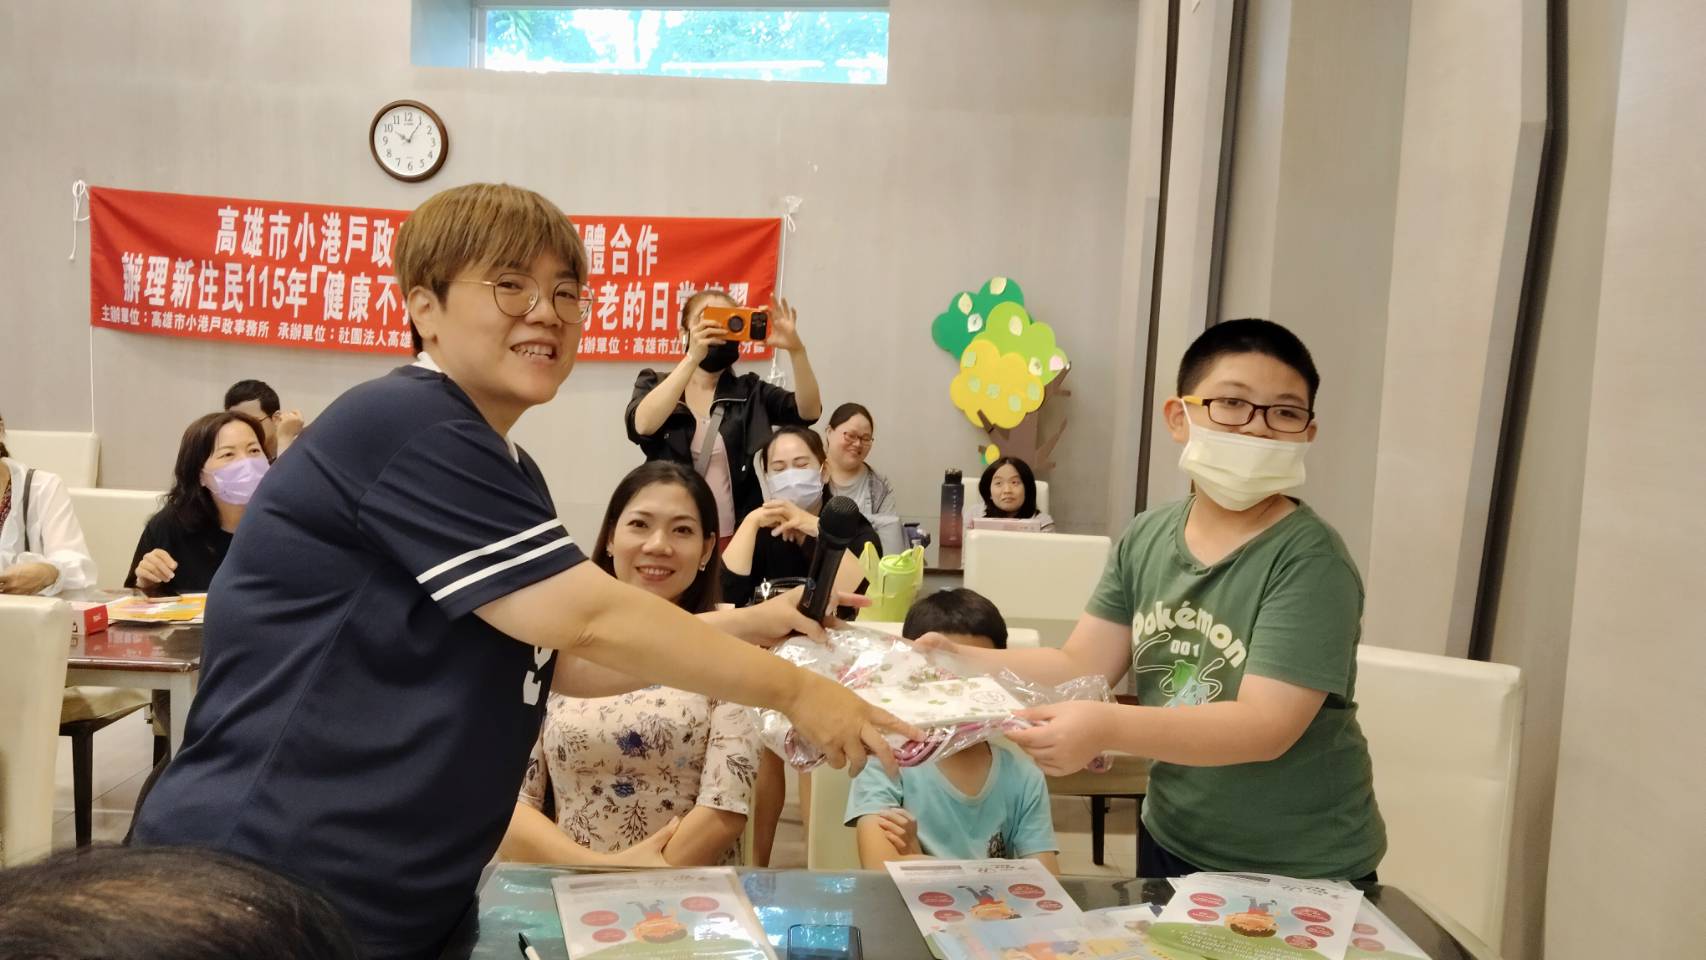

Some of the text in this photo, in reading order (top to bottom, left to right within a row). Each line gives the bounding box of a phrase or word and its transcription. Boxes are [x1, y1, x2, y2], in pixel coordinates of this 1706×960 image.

[393, 115, 401, 125] 11
[404, 111, 413, 122] 12
[384, 123, 394, 133] 10
[427, 125, 433, 136] 2
[382, 135, 389, 146] 9
[431, 137, 436, 148] 3
[386, 148, 393, 158] 8
[427, 150, 433, 159] 4
[395, 157, 401, 167] 7
[407, 161, 413, 171] 6
[420, 159, 425, 169] 5
[215, 205, 659, 276] 高雄市小港戶政 體合作
[121, 251, 410, 326] 辦理新住民115年「健康不
[577, 335, 687, 355] 辦單位：高雄市立
[1170, 639, 1200, 657] 001
